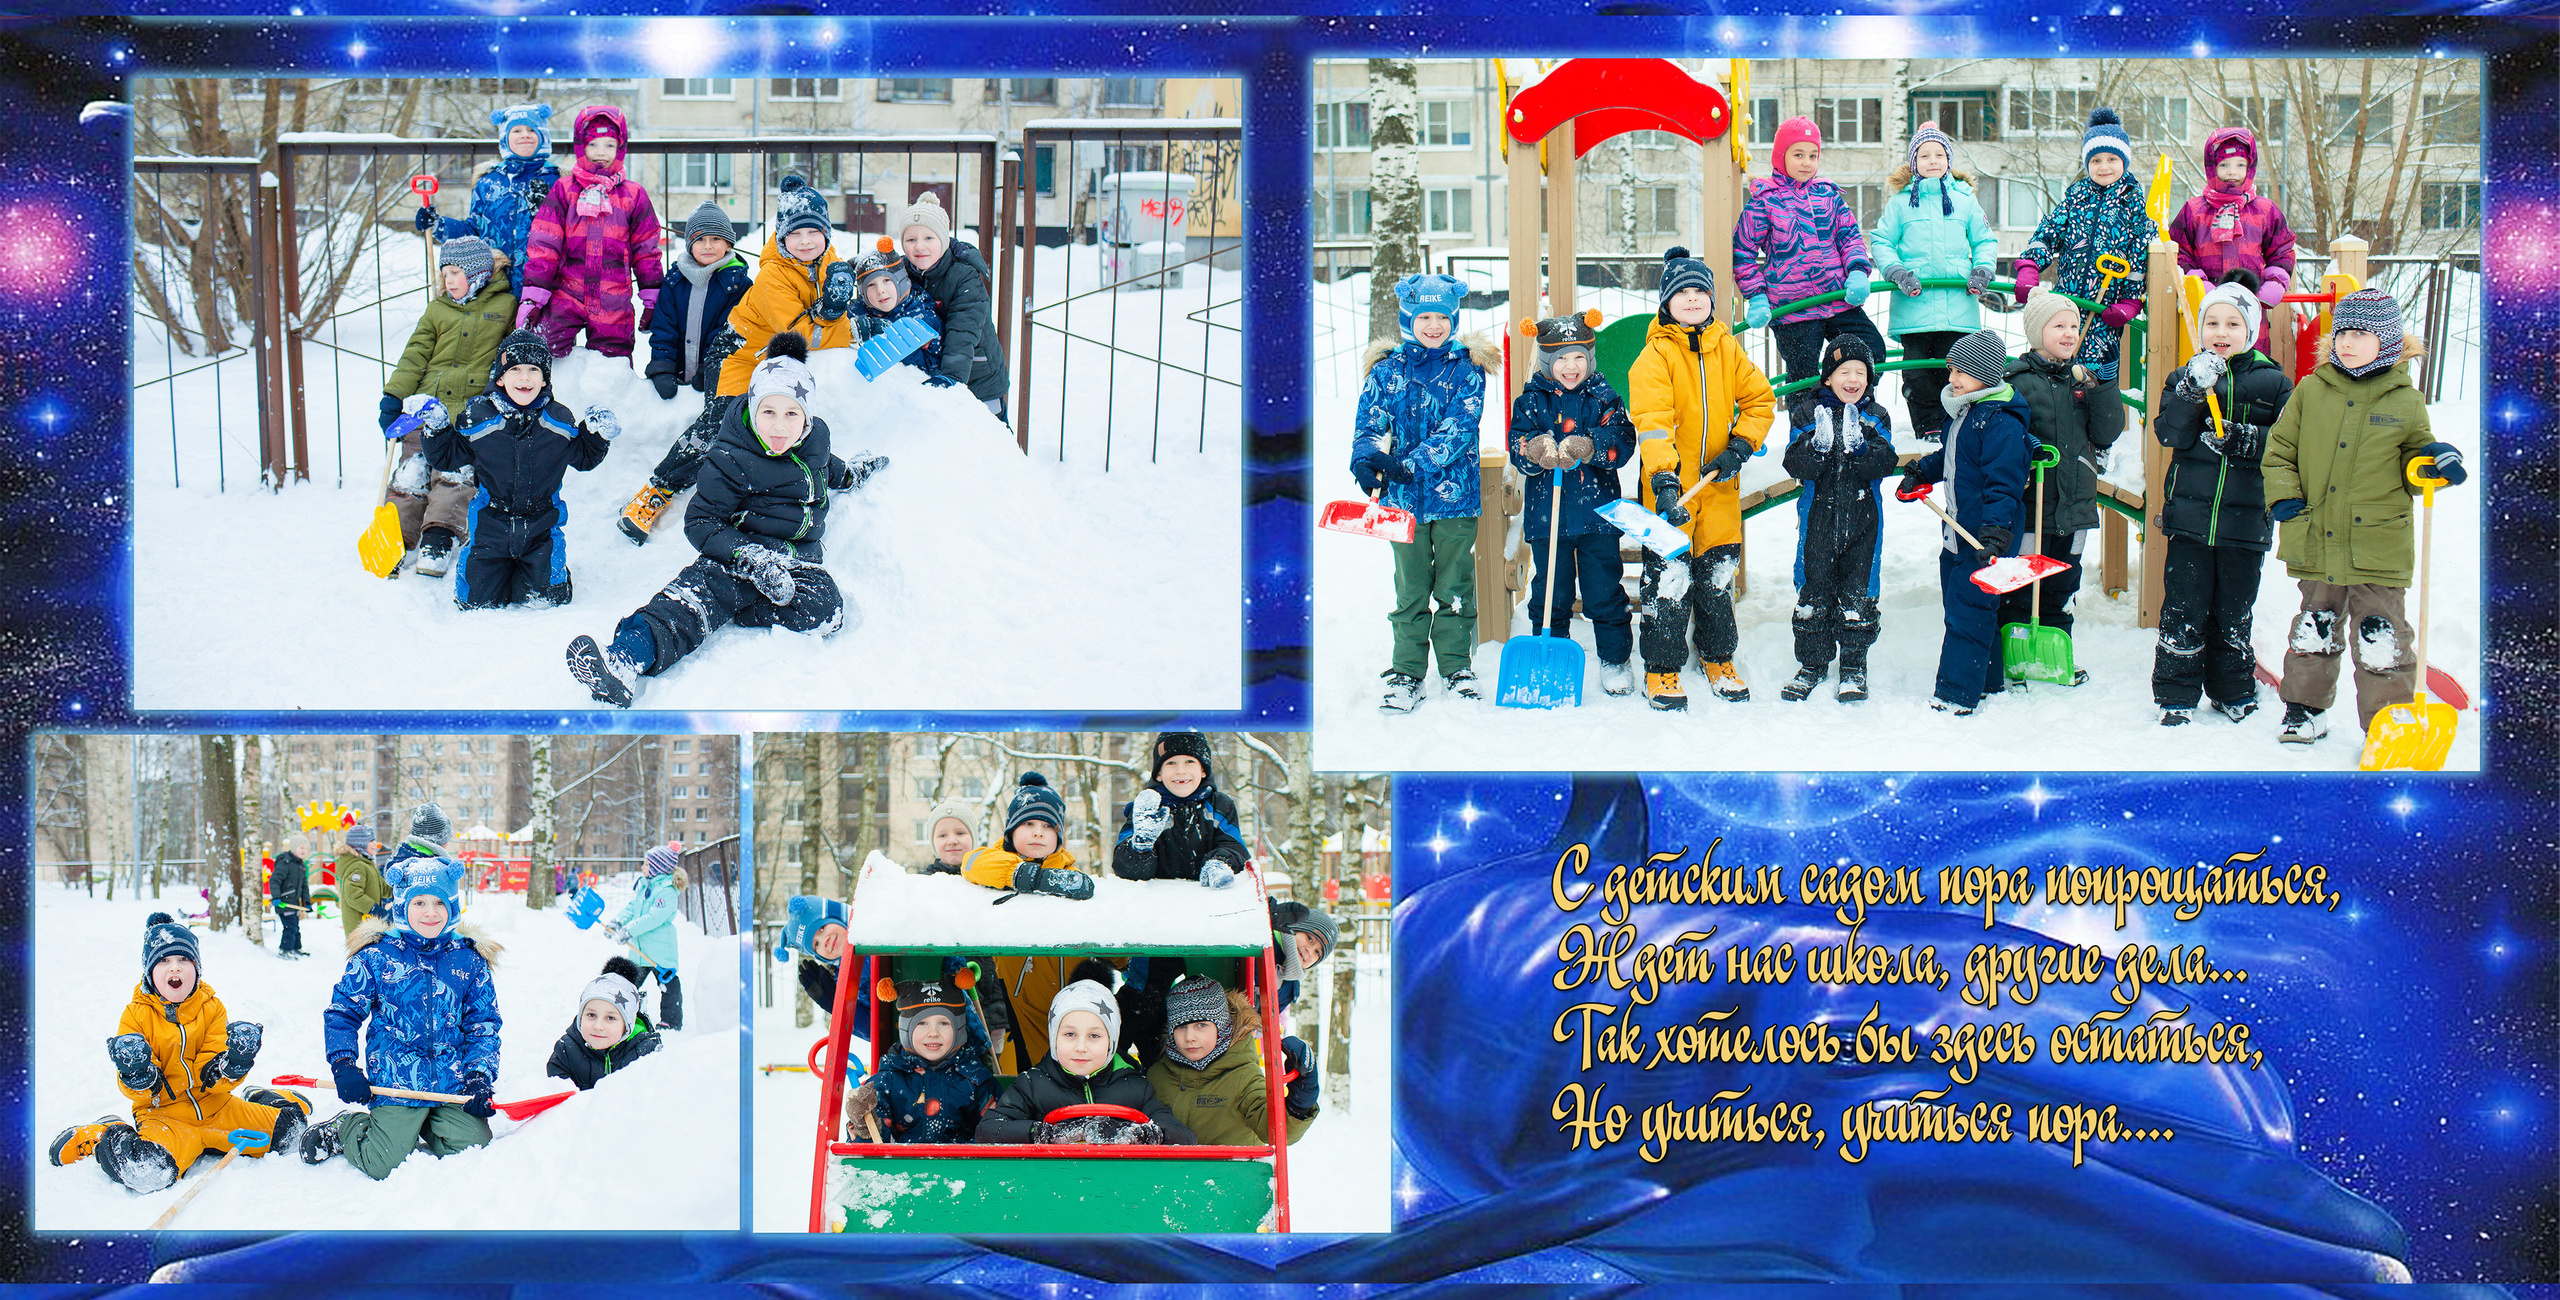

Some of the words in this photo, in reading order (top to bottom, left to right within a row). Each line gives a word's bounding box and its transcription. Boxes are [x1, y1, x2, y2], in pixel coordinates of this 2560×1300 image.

[1420, 294, 1442, 303] REIKE
[412, 875, 437, 884] REIKE
[796, 923, 806, 946] REIKE
[923, 995, 942, 1004] reike
